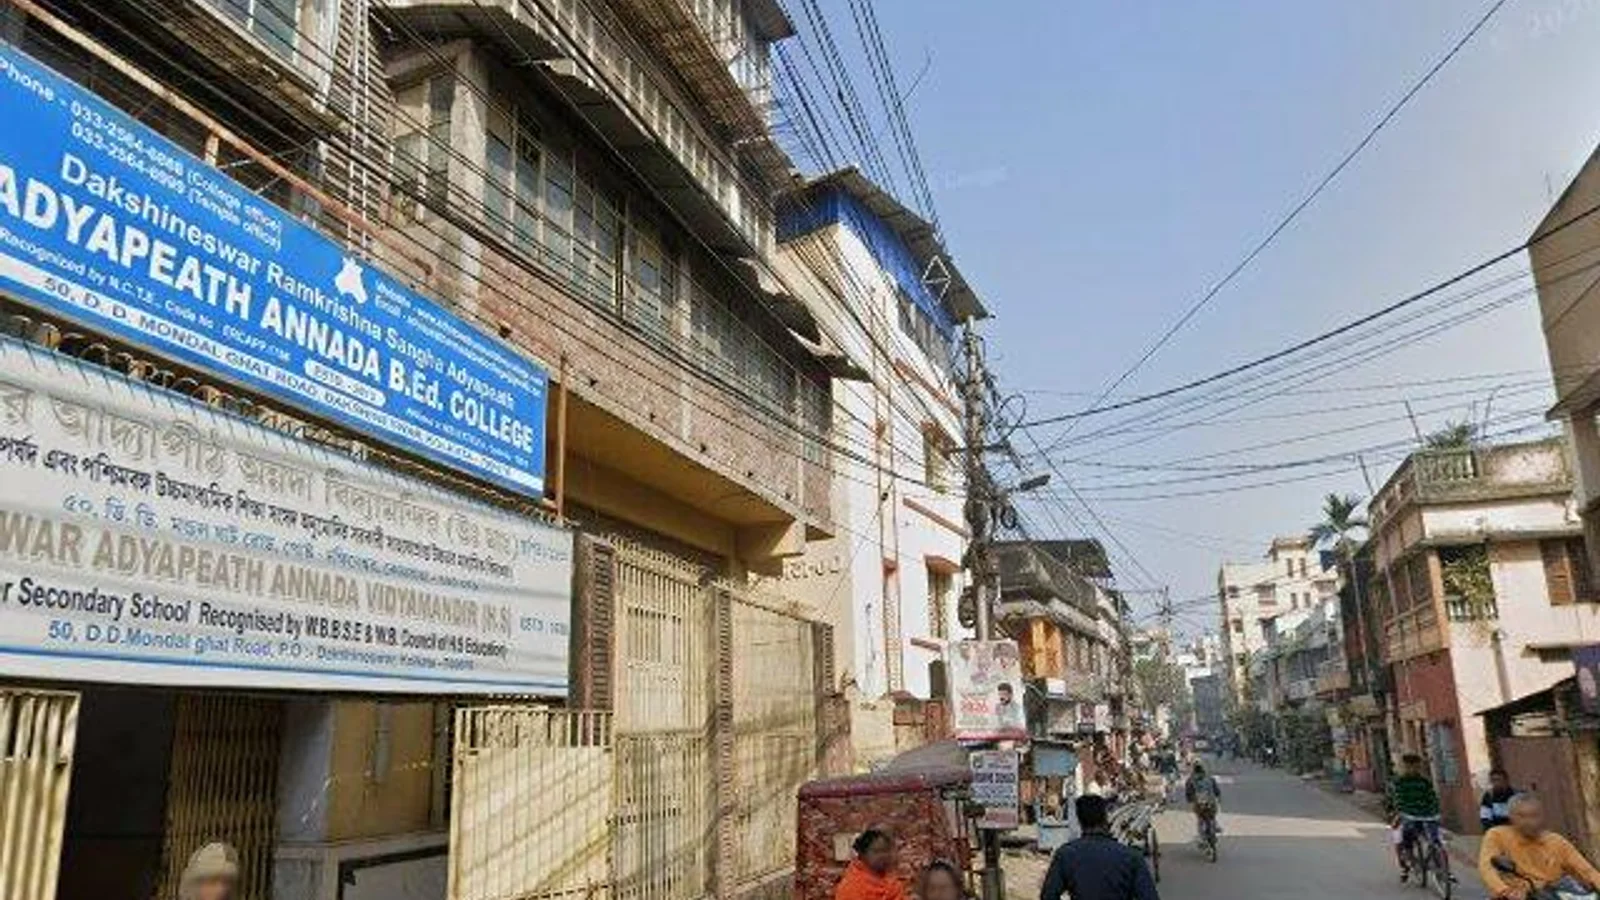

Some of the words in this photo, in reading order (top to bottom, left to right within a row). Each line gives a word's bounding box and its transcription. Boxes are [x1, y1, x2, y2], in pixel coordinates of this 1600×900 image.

[0, 164, 251, 321] ADYAPEATH
[260, 296, 381, 378] ANNADA
[389, 357, 444, 408] B.Ed.
[450, 391, 533, 454] COLLEGE
[61, 152, 260, 276] Dakshineswar
[267, 261, 381, 341] Ramkrishna
[386, 327, 443, 375] Sangha
[447, 362, 514, 411] Adyapeath
[139, 314, 220, 358] MONDAL
[225, 351, 270, 384] GHAT
[43, 449, 78, 476] এবং
[51, 396, 226, 479] আদ্যাপীঠ
[237, 450, 311, 500] অন্নদা
[18, 577, 125, 619] Secondary
[129, 592, 190, 622] School
[199, 603, 282, 637] Recognised
[286, 614, 302, 639] by
[365, 624, 373, 643] &
[402, 630, 436, 650] Council
[92, 530, 264, 592] ADYAPEATH
[271, 564, 360, 610] ANNADA
[367, 583, 477, 629] VIDYAMANDIR
[48, 621, 77, 641] 50,
[195, 634, 229, 655] ghat
